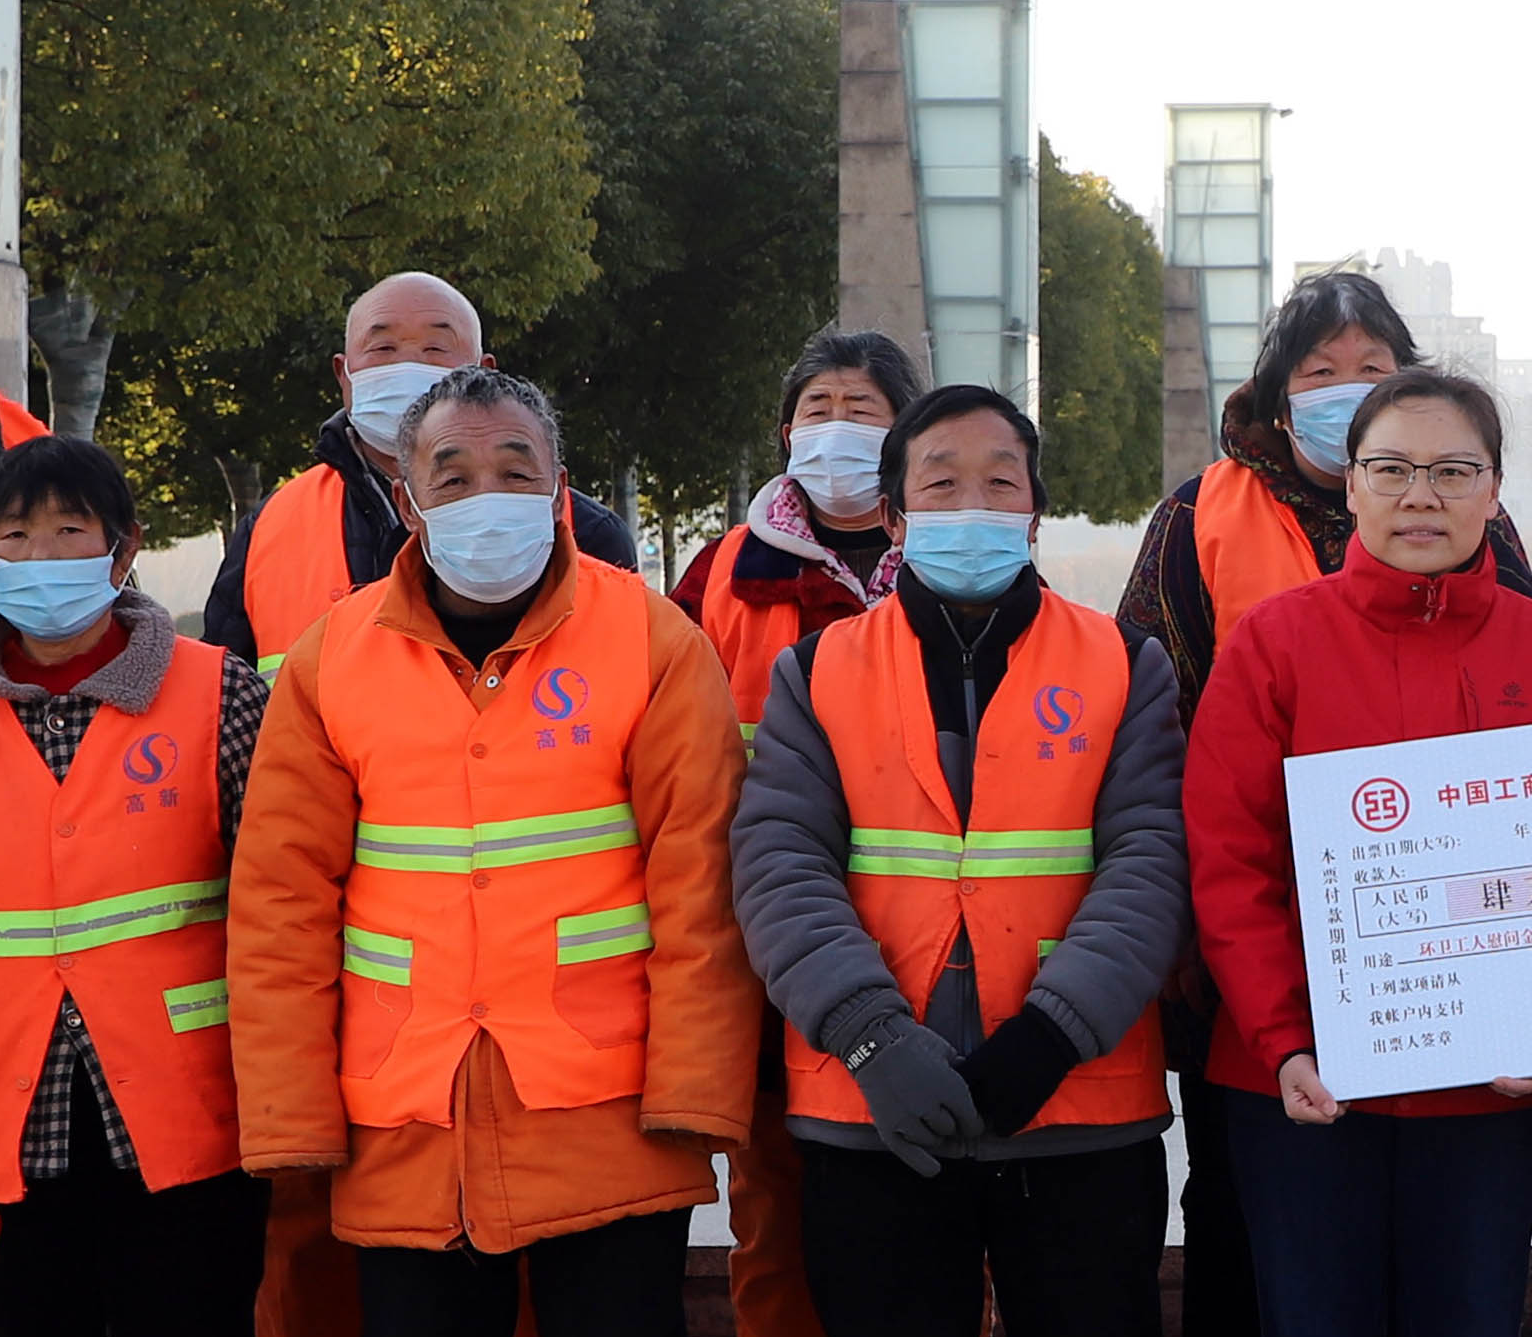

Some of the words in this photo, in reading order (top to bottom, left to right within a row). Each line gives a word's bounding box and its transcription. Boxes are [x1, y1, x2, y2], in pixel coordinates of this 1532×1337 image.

[537, 724, 590, 750] 高新
[1037, 733, 1087, 760] 高新
[126, 787, 179, 814] 高新
[1514, 822, 1530, 839] 年
[1353, 865, 1406, 885] 收款人:
[1371, 886, 1429, 908] 人民币
[1363, 953, 1393, 969] 用途
